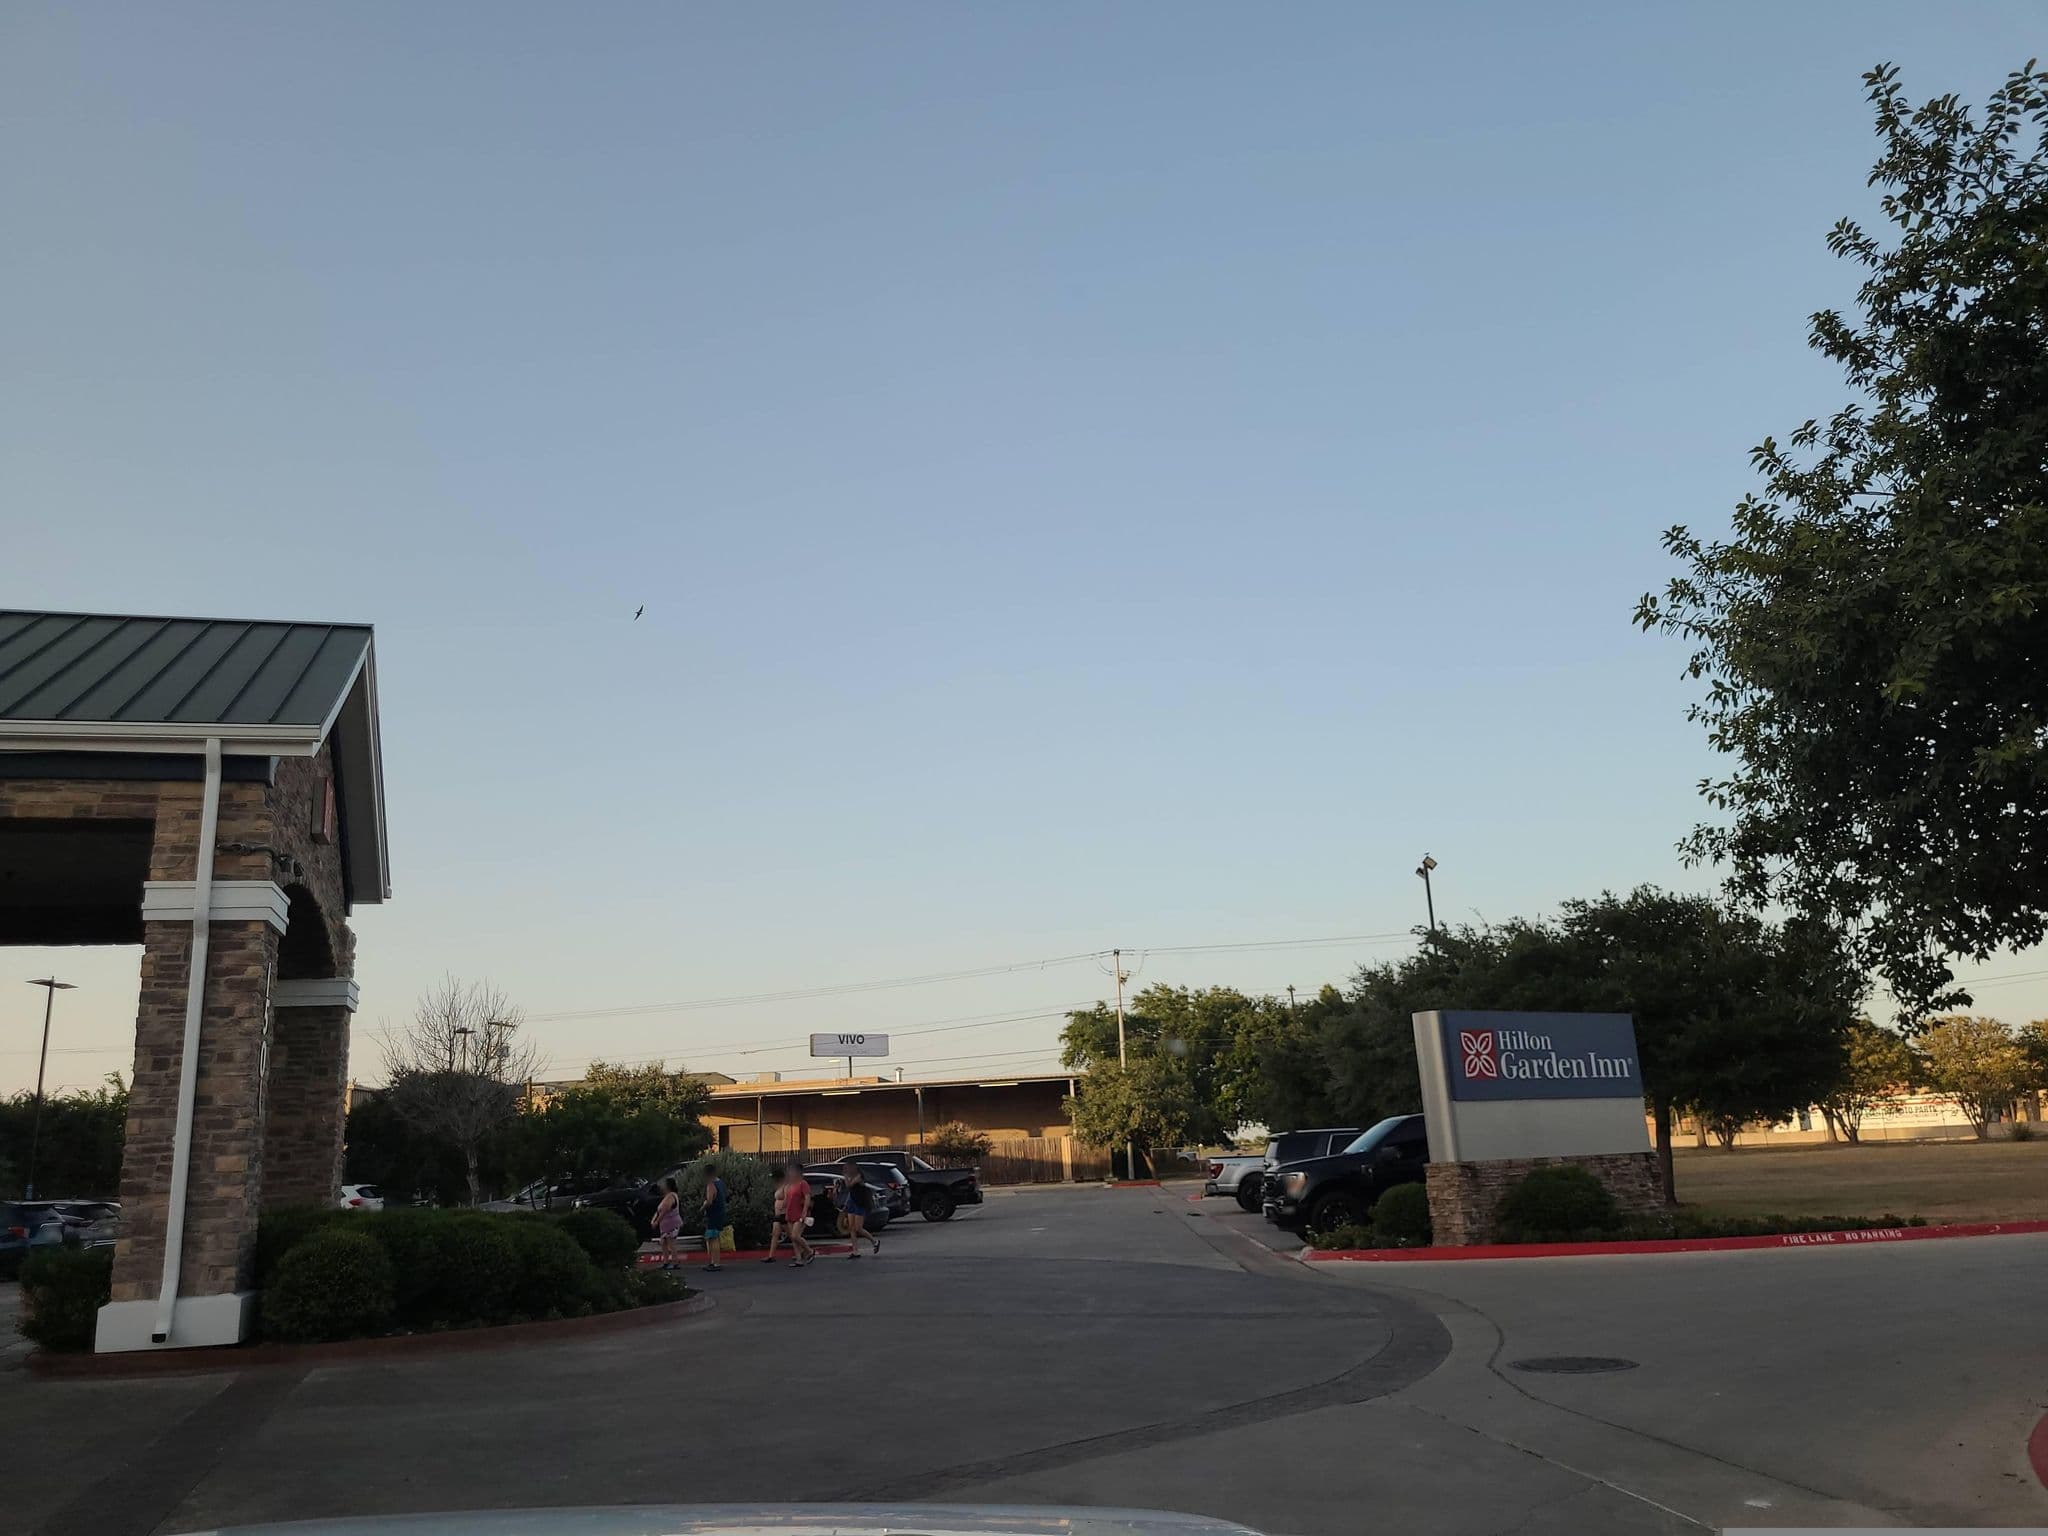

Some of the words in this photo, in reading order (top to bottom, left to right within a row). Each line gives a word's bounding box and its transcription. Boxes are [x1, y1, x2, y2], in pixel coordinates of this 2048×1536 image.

[838, 1034, 865, 1045] VIVO
[1498, 1030, 1552, 1050] Hilton
[1500, 1051, 1589, 1080] Garden
[1588, 1052, 1632, 1079] Inn
[1782, 1235, 1807, 1244] FIRE
[1809, 1233, 1836, 1243] LANE
[1844, 1232, 1859, 1241] NO
[1860, 1229, 1902, 1240] PARKING
